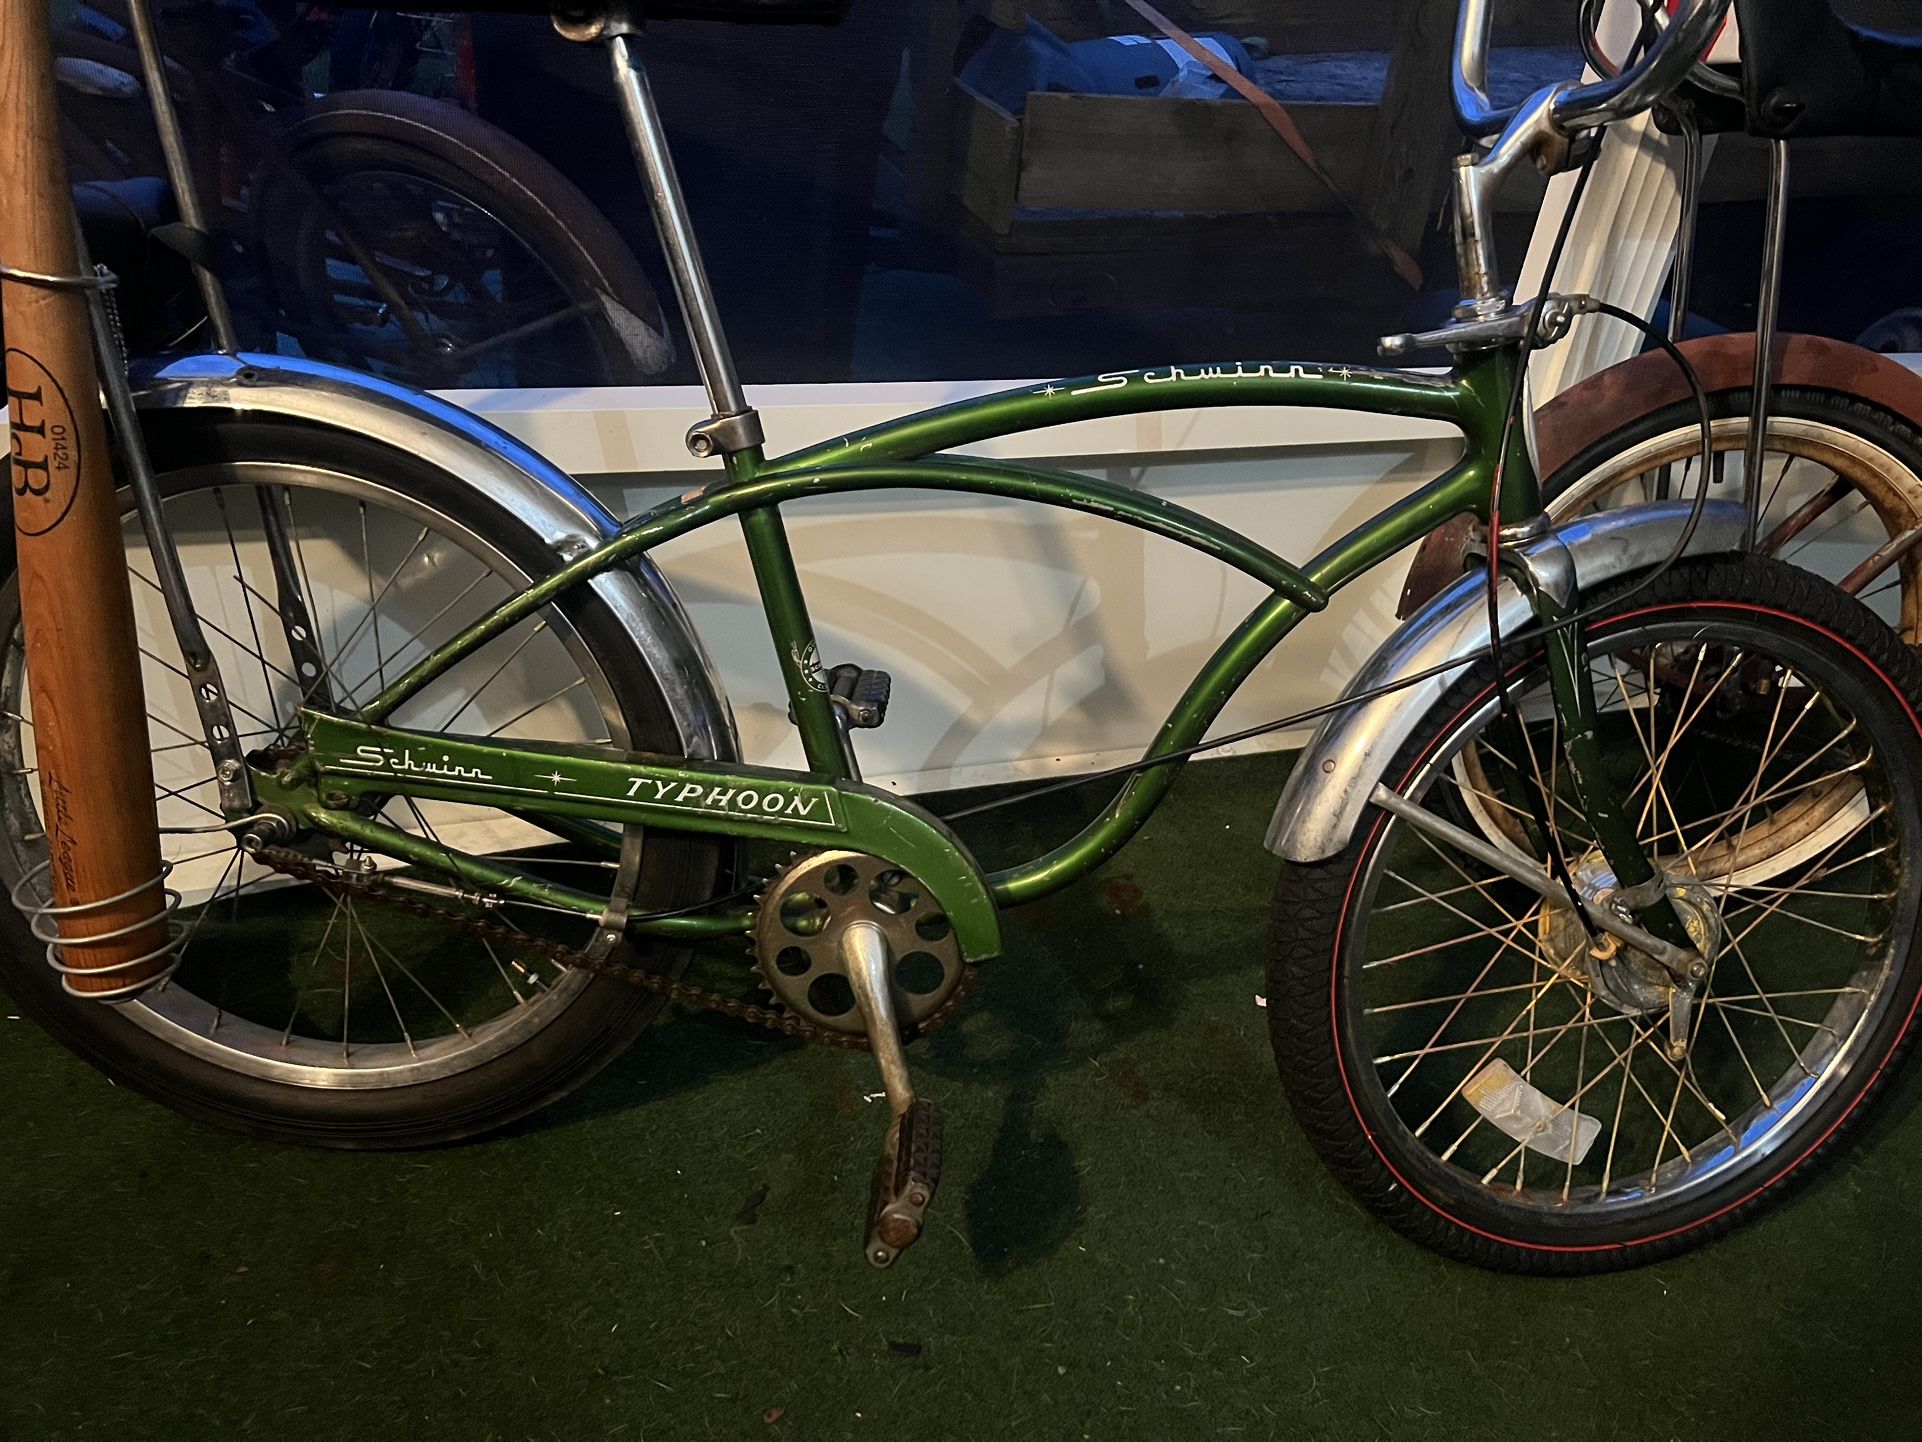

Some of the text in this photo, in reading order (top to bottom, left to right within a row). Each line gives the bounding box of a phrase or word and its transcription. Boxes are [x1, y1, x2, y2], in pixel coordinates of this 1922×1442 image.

[1070, 361, 1323, 396] Schwinn
[50, 424, 70, 471] 01424
[340, 745, 493, 780] Schwinn
[625, 776, 818, 816] TYPHOON
